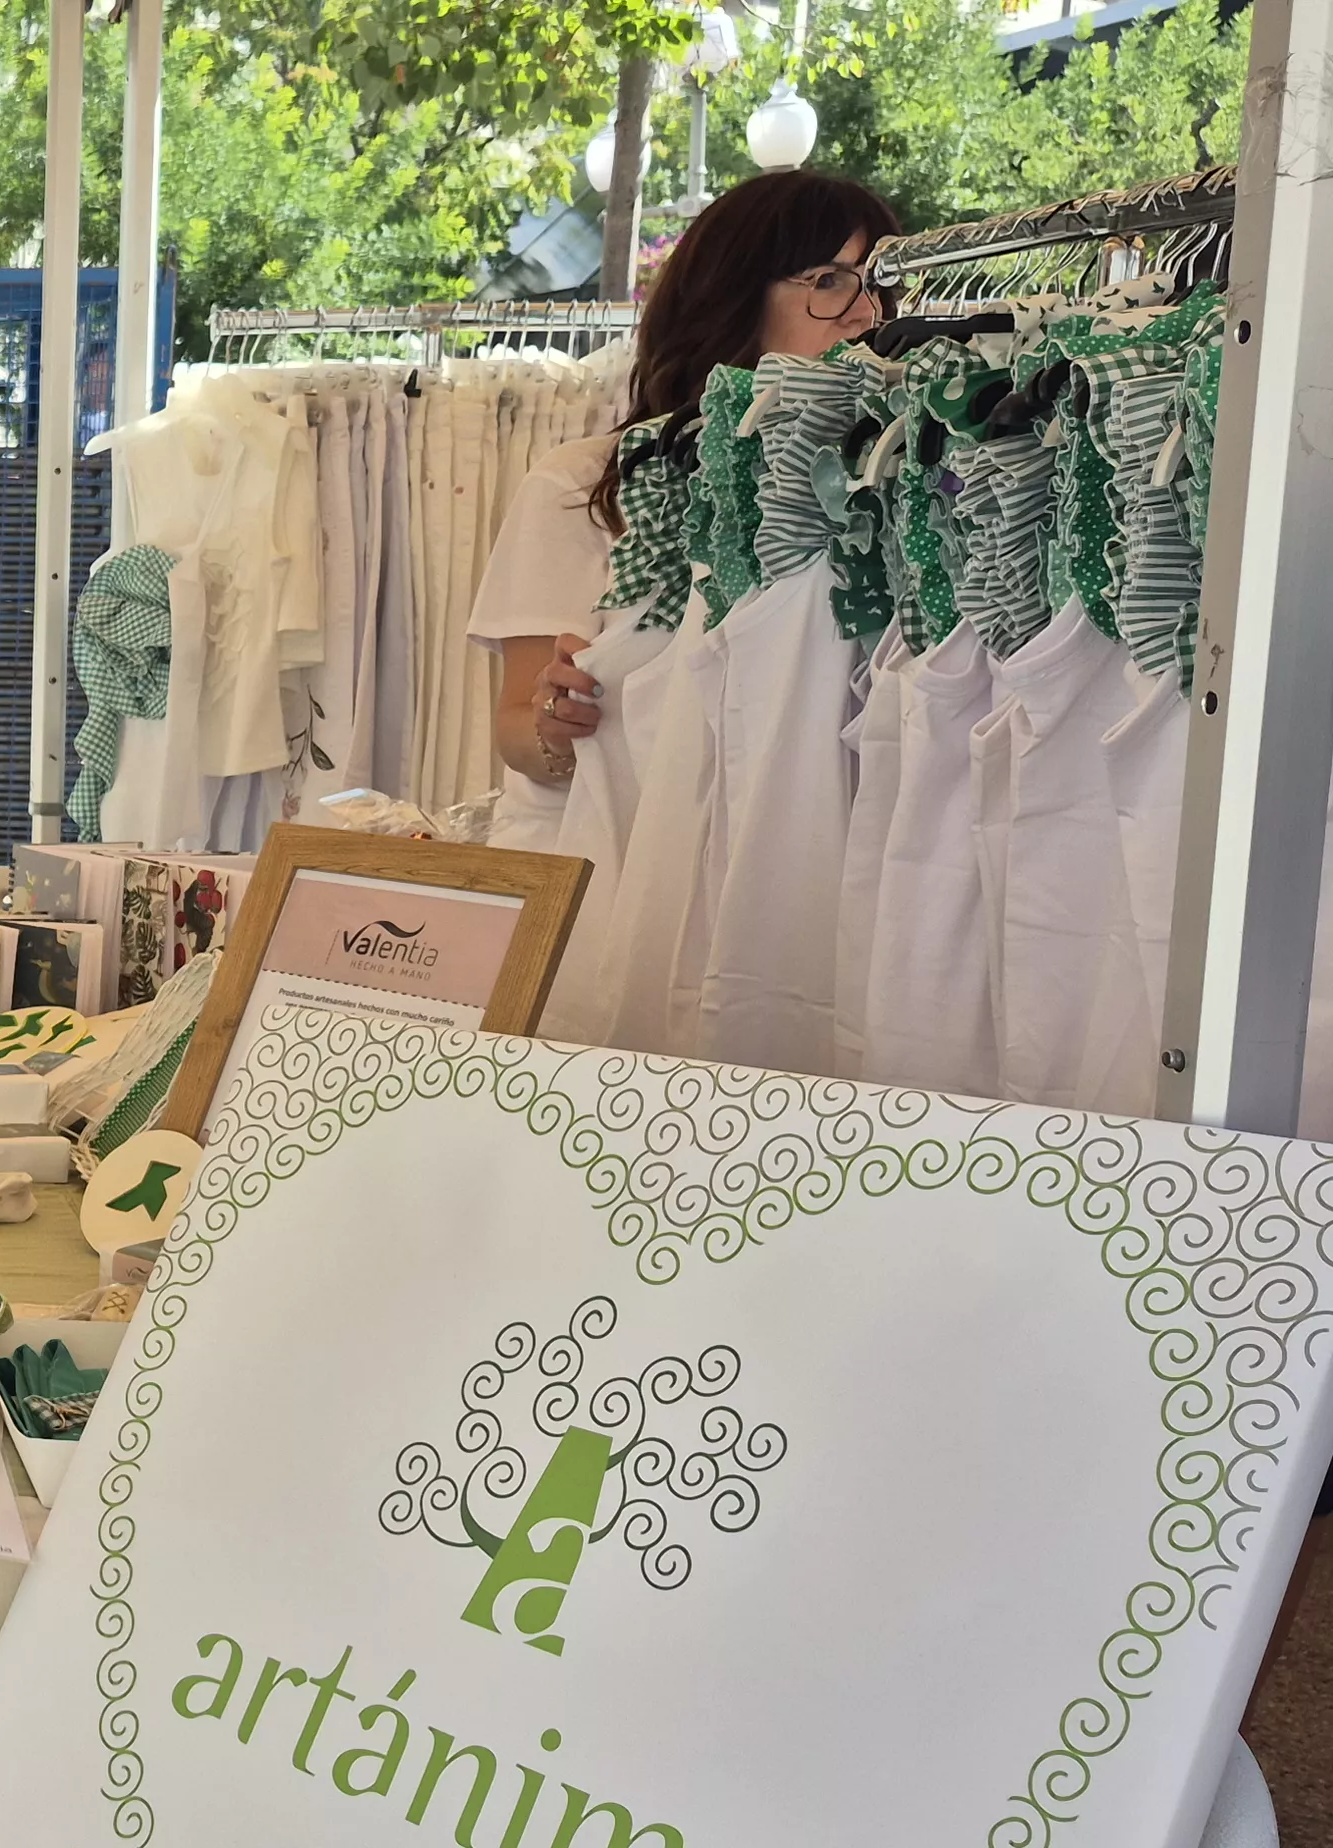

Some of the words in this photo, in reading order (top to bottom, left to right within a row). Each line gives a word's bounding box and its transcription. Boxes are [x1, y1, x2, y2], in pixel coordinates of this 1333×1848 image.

[344, 921, 439, 967] Valentia
[350, 960, 384, 974] HECHO
[388, 966, 396, 975] A
[400, 968, 431, 981] MANO
[278, 988, 314, 1001] Productos
[314, 995, 356, 1008] artesanales
[358, 1001, 384, 1014] hechos
[401, 1011, 428, 1022] mucho
[429, 1015, 455, 1026] cariño
